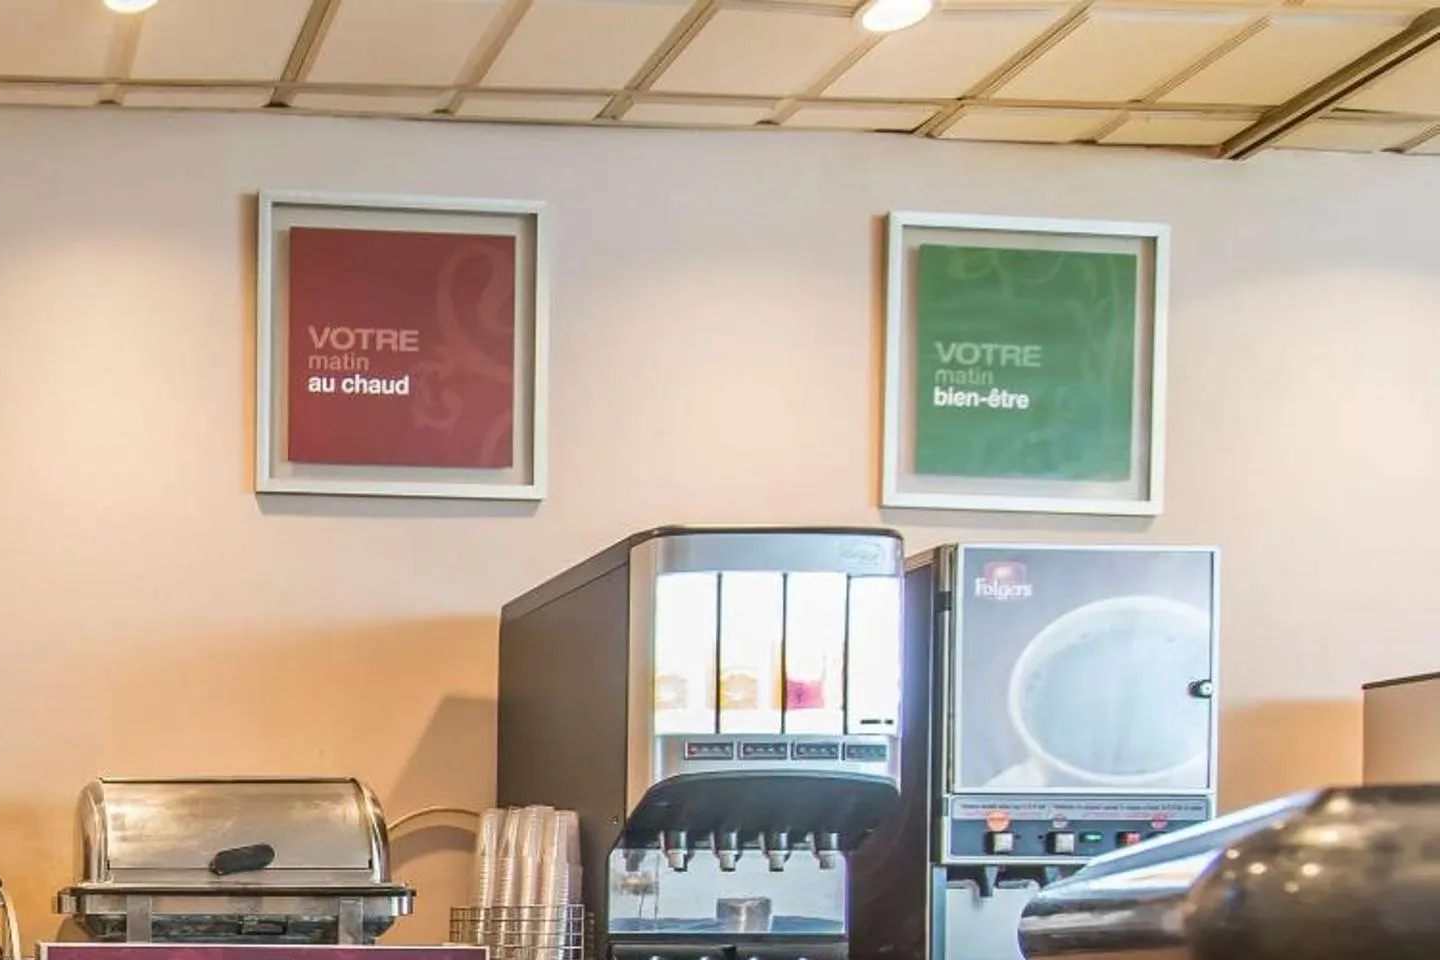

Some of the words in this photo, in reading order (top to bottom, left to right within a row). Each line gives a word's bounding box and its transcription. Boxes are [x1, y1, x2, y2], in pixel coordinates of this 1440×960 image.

[308, 326, 420, 352] VOTRE
[308, 352, 370, 371] matin
[934, 341, 1042, 368] VOTRE
[308, 376, 335, 393] au
[341, 375, 410, 395] chaud
[934, 368, 994, 386] matin
[933, 386, 1030, 409] bien-être
[975, 577, 1032, 600] Folgers
